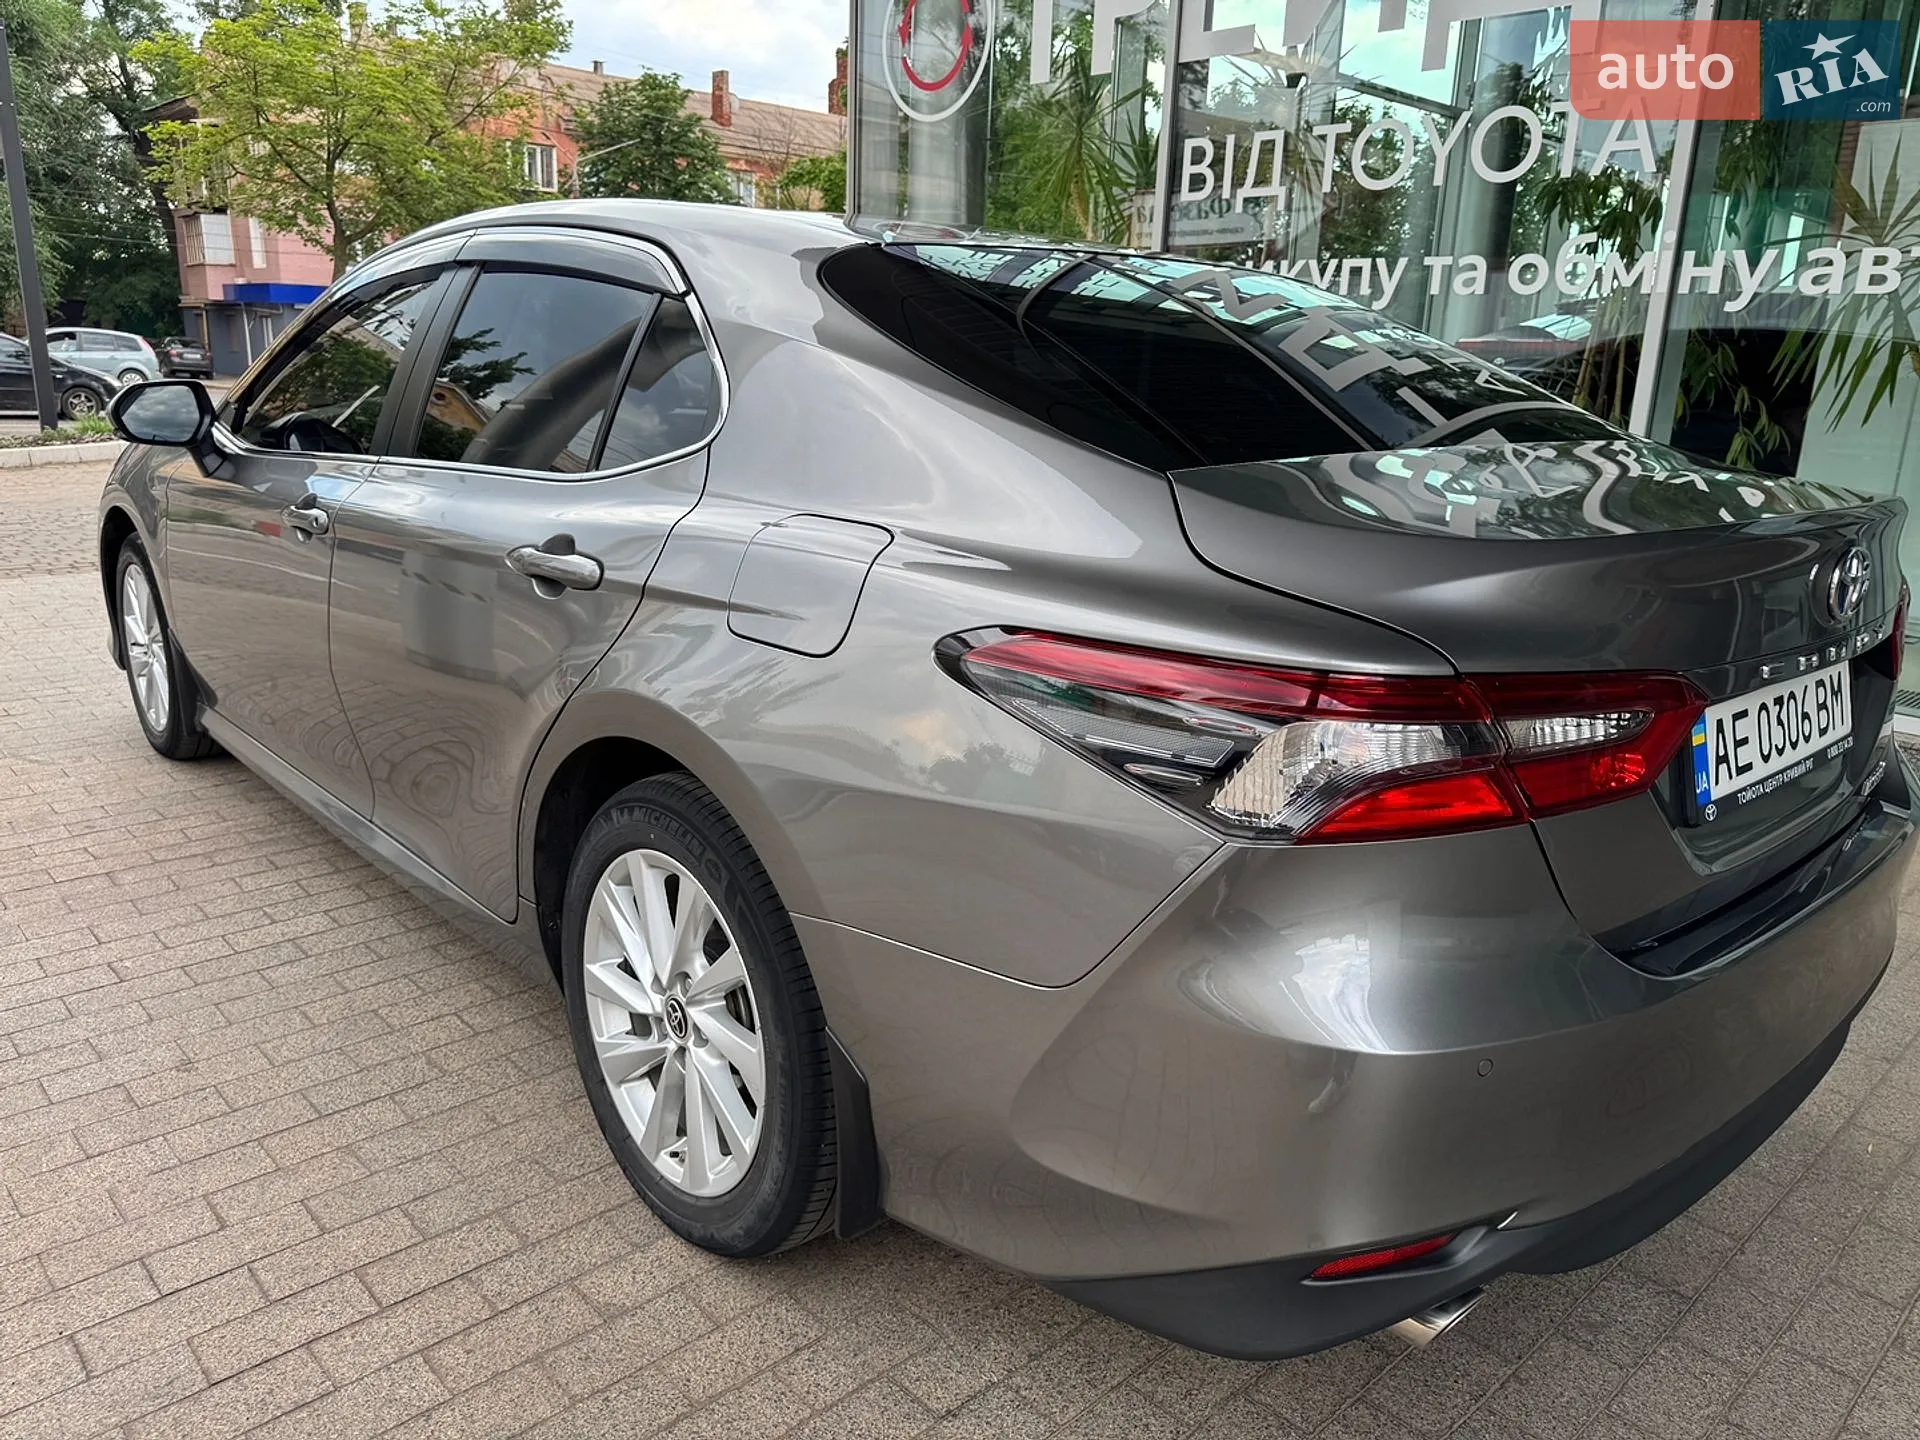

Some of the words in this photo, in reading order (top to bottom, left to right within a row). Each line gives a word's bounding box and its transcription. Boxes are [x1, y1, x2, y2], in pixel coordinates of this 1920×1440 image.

[1180, 129, 1288, 213] ВІД
[1312, 95, 1656, 194] TOYOTA
[1423, 253, 1488, 295] та
[1508, 230, 1779, 312] обміну
[1798, 246, 1920, 295] ав
[1715, 708, 1753, 786] AE
[1757, 685, 1812, 764] 0306
[1815, 671, 1844, 738] BM
[1695, 770, 1709, 794] UA
